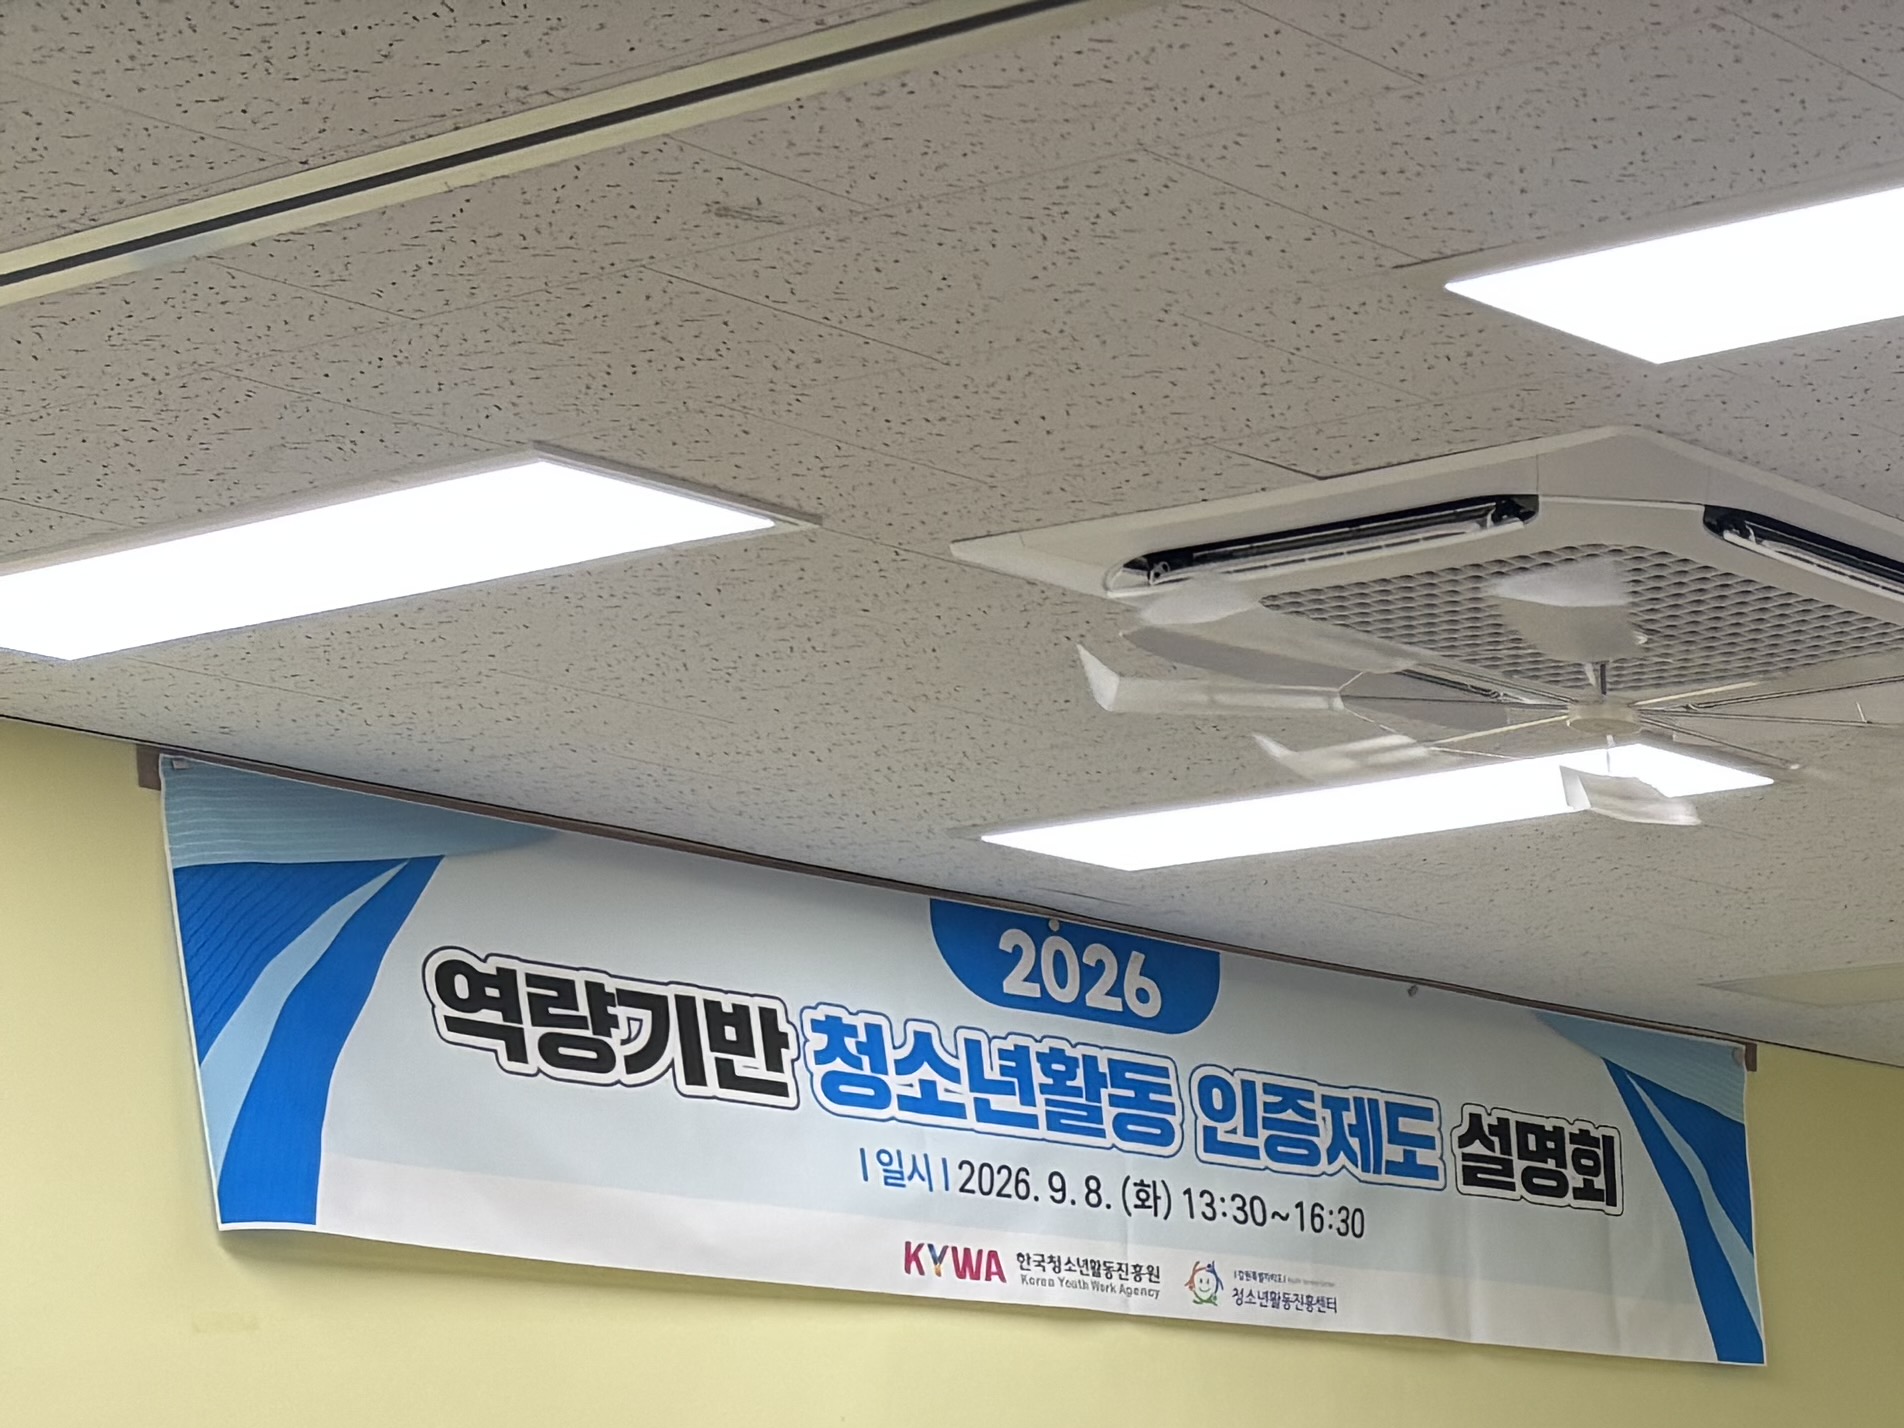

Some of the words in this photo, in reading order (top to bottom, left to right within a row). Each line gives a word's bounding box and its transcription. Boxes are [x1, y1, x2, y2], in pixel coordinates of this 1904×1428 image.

[1000, 926, 1164, 1017] 2026
[431, 956, 792, 1102] 역량기반
[806, 1012, 1178, 1147] 청소년활동
[1198, 1073, 1442, 1183] 인증제도
[1455, 1111, 1618, 1207] 설명회
[876, 1149, 933, 1192] 일시
[958, 1160, 1039, 1201] 2026.
[1048, 1171, 1076, 1205] 9.
[1085, 1175, 1112, 1209] 8.
[1121, 1175, 1171, 1220] (화)
[1182, 1188, 1365, 1238] 13:30~16:30
[904, 1240, 1007, 1283] KYWA
[1016, 1252, 1161, 1284] 한국청소년활동진흥원
[1058, 1276, 1089, 1291] Youth
[1232, 1287, 1338, 1314] 청소년활동진흥센터
